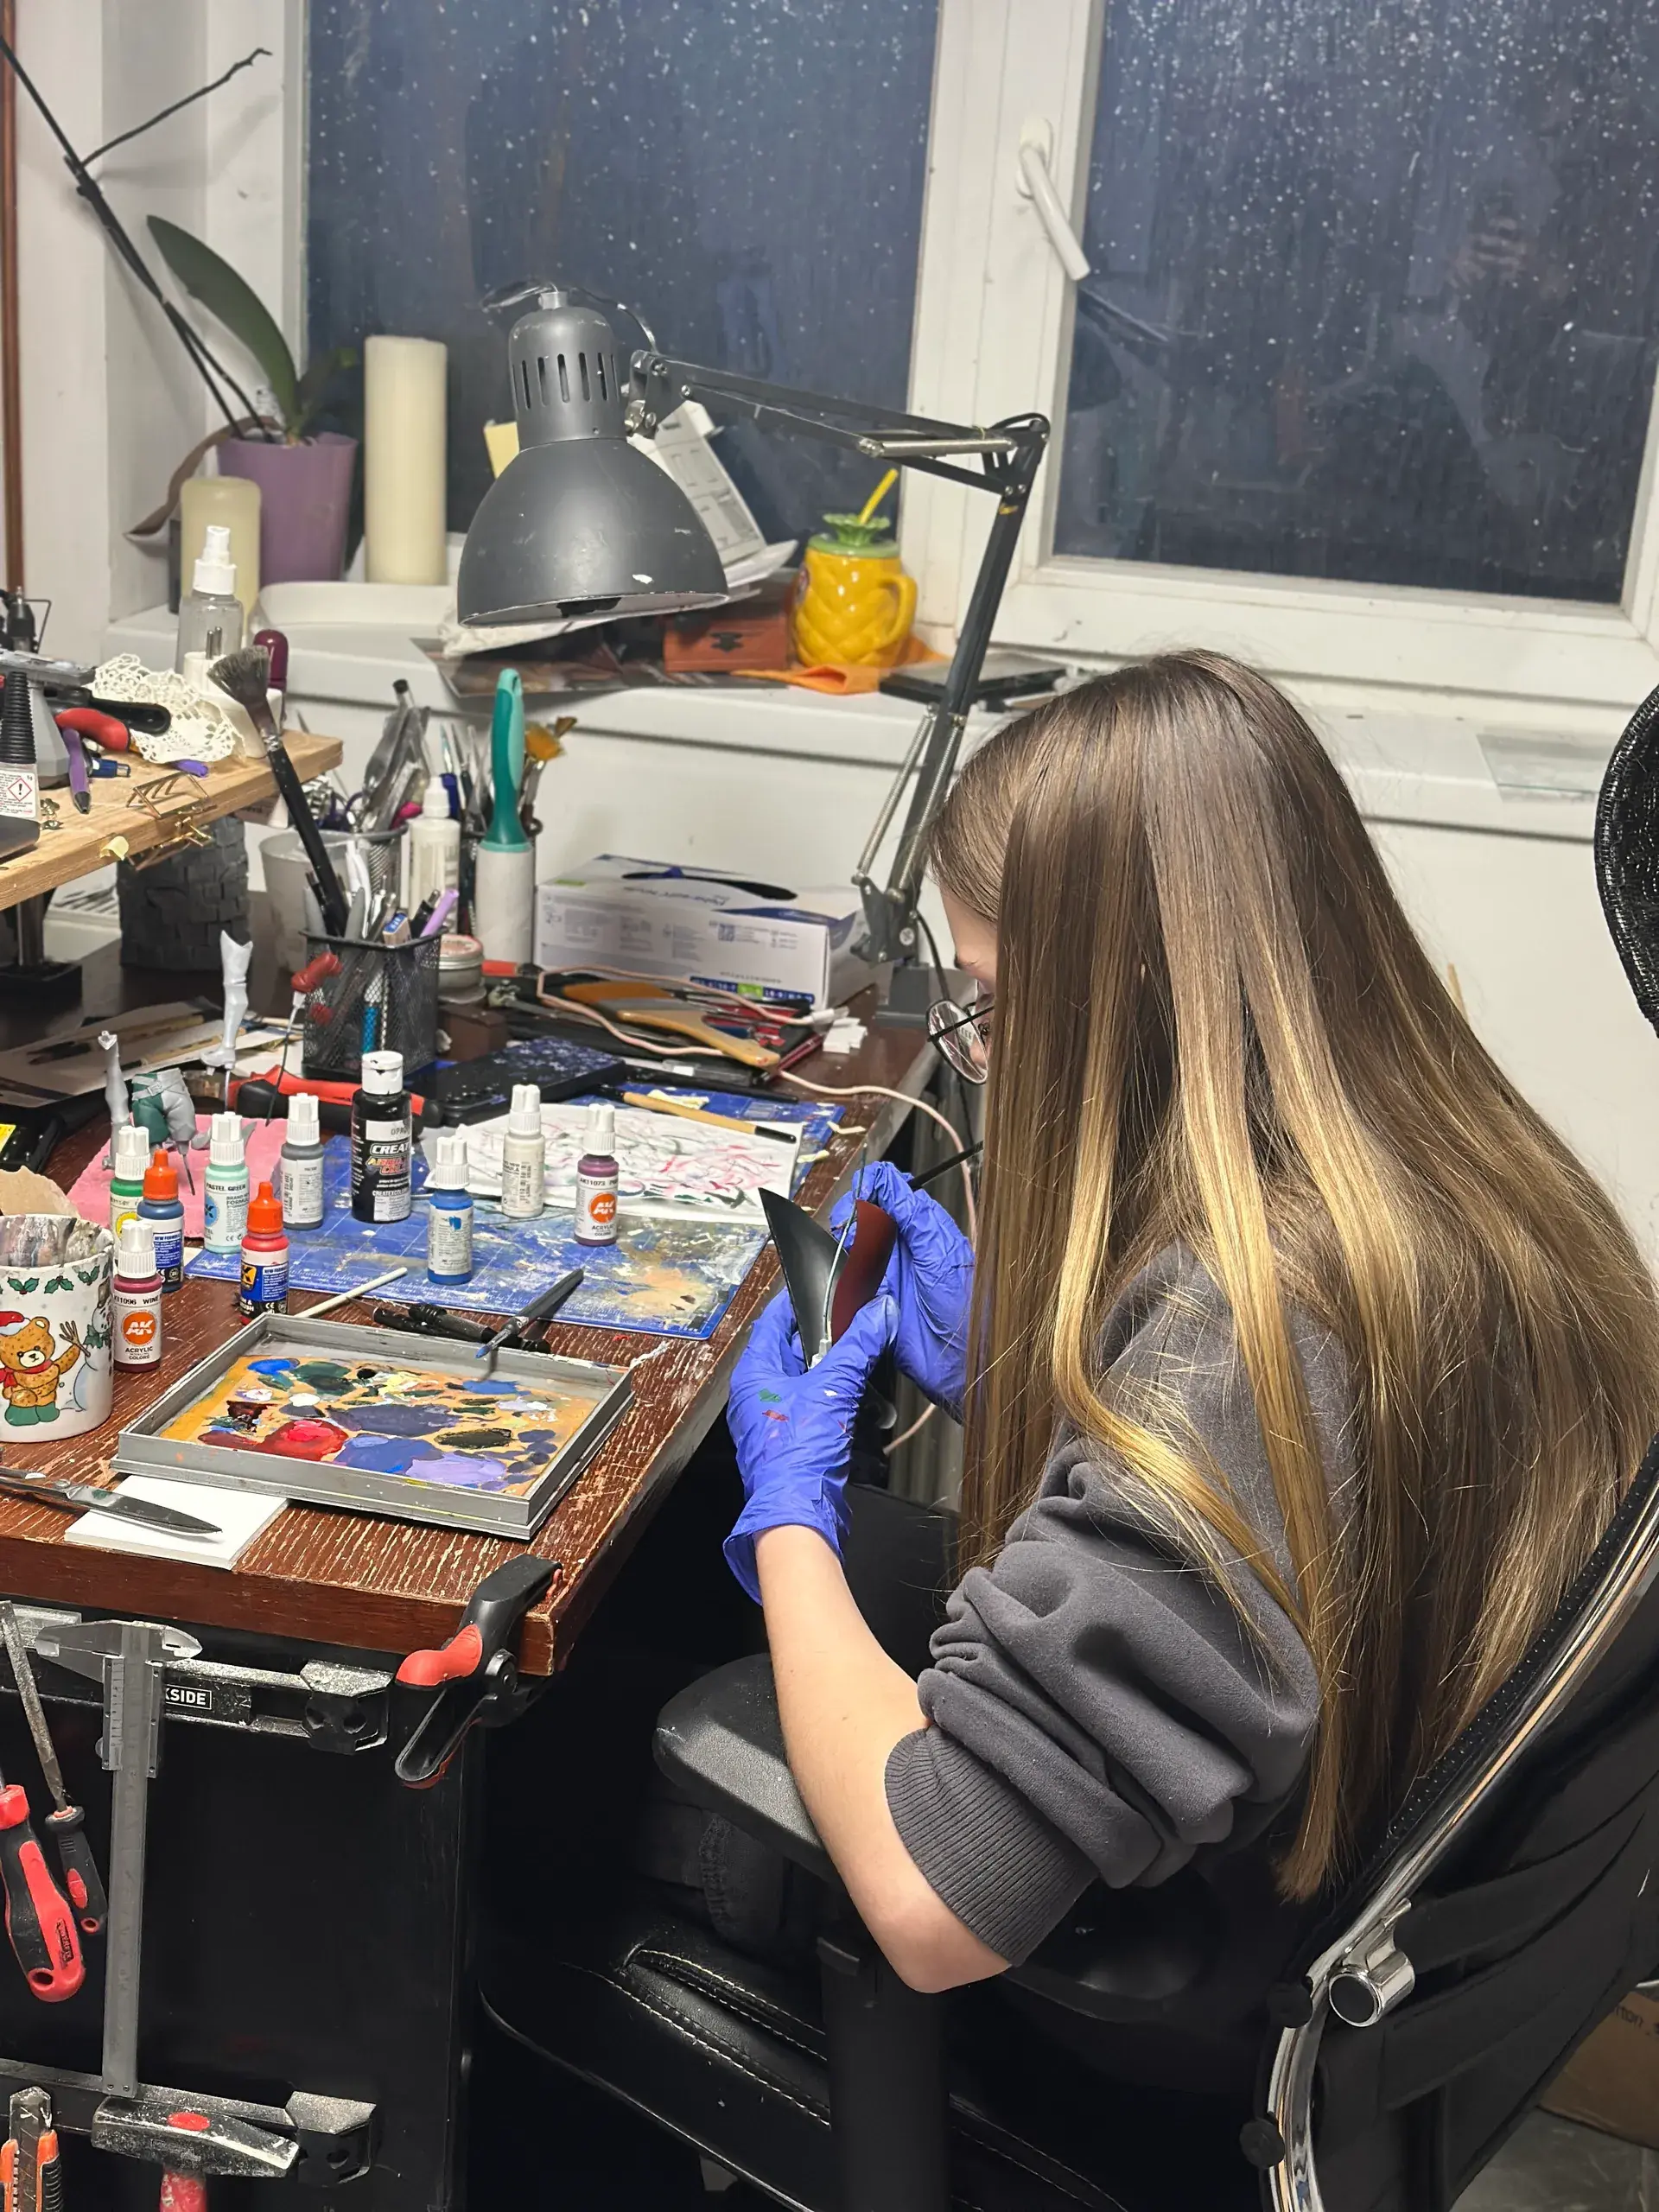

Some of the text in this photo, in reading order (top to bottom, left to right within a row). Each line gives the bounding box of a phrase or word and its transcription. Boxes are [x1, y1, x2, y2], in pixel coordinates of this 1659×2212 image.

[207, 1183, 226, 1192] PASTEL
[143, 1295, 160, 1305] WINE
[126, 1319, 154, 1336] AK
